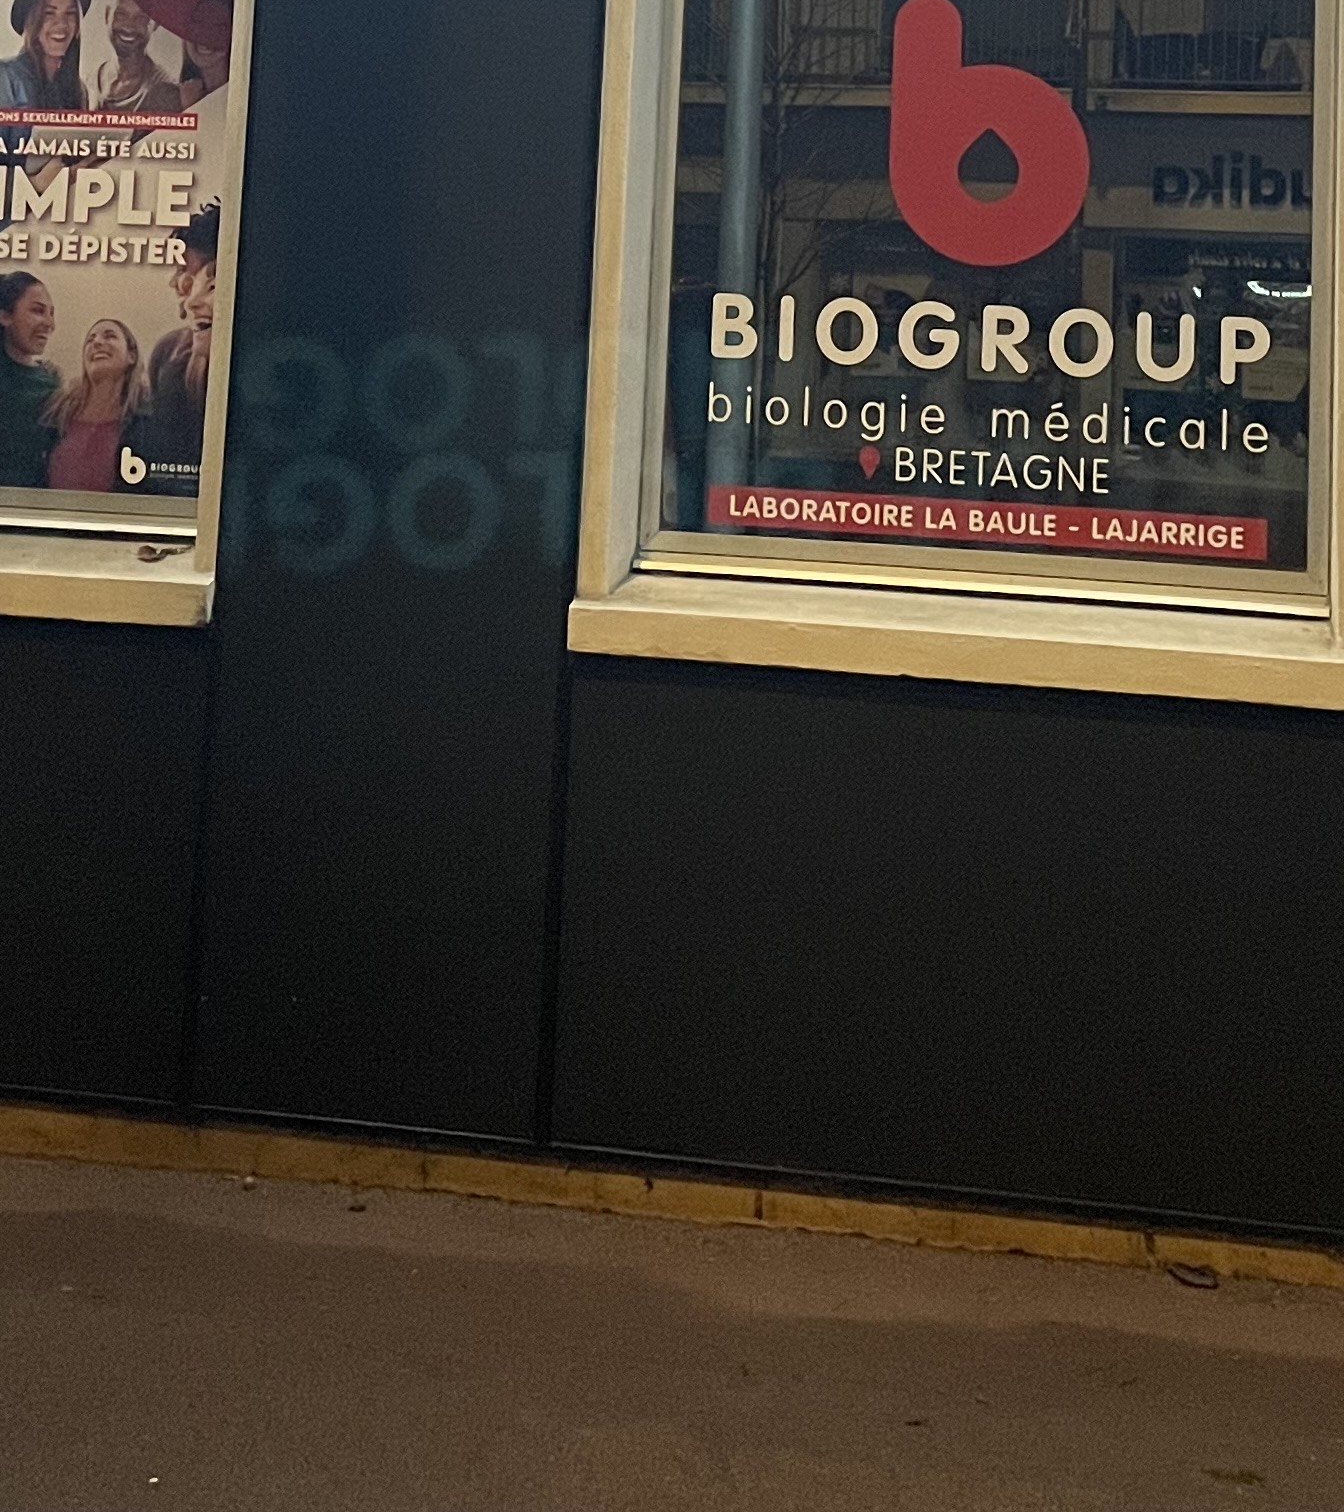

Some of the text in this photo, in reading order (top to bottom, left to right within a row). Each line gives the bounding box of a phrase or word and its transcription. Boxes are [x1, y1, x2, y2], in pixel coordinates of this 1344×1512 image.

[22, 112, 103, 125] SEXUELLEMENT
[106, 114, 196, 128] TRANSMISSIBLES
[13, 137, 91, 157] JAMAIS
[96, 135, 131, 158] ÉTÉ
[137, 142, 196, 160] AUSSI
[38, 228, 187, 266] DÉPISTER
[711, 292, 1270, 385] BIOGROUP
[707, 381, 1270, 454] biologie médicale
[894, 446, 1110, 495] BRETAGNE
[728, 494, 913, 527] LABORATOIRE
[924, 507, 957, 531] LA
[968, 509, 1057, 537] BAULE
[1091, 517, 1245, 550] LAJARRIGE
